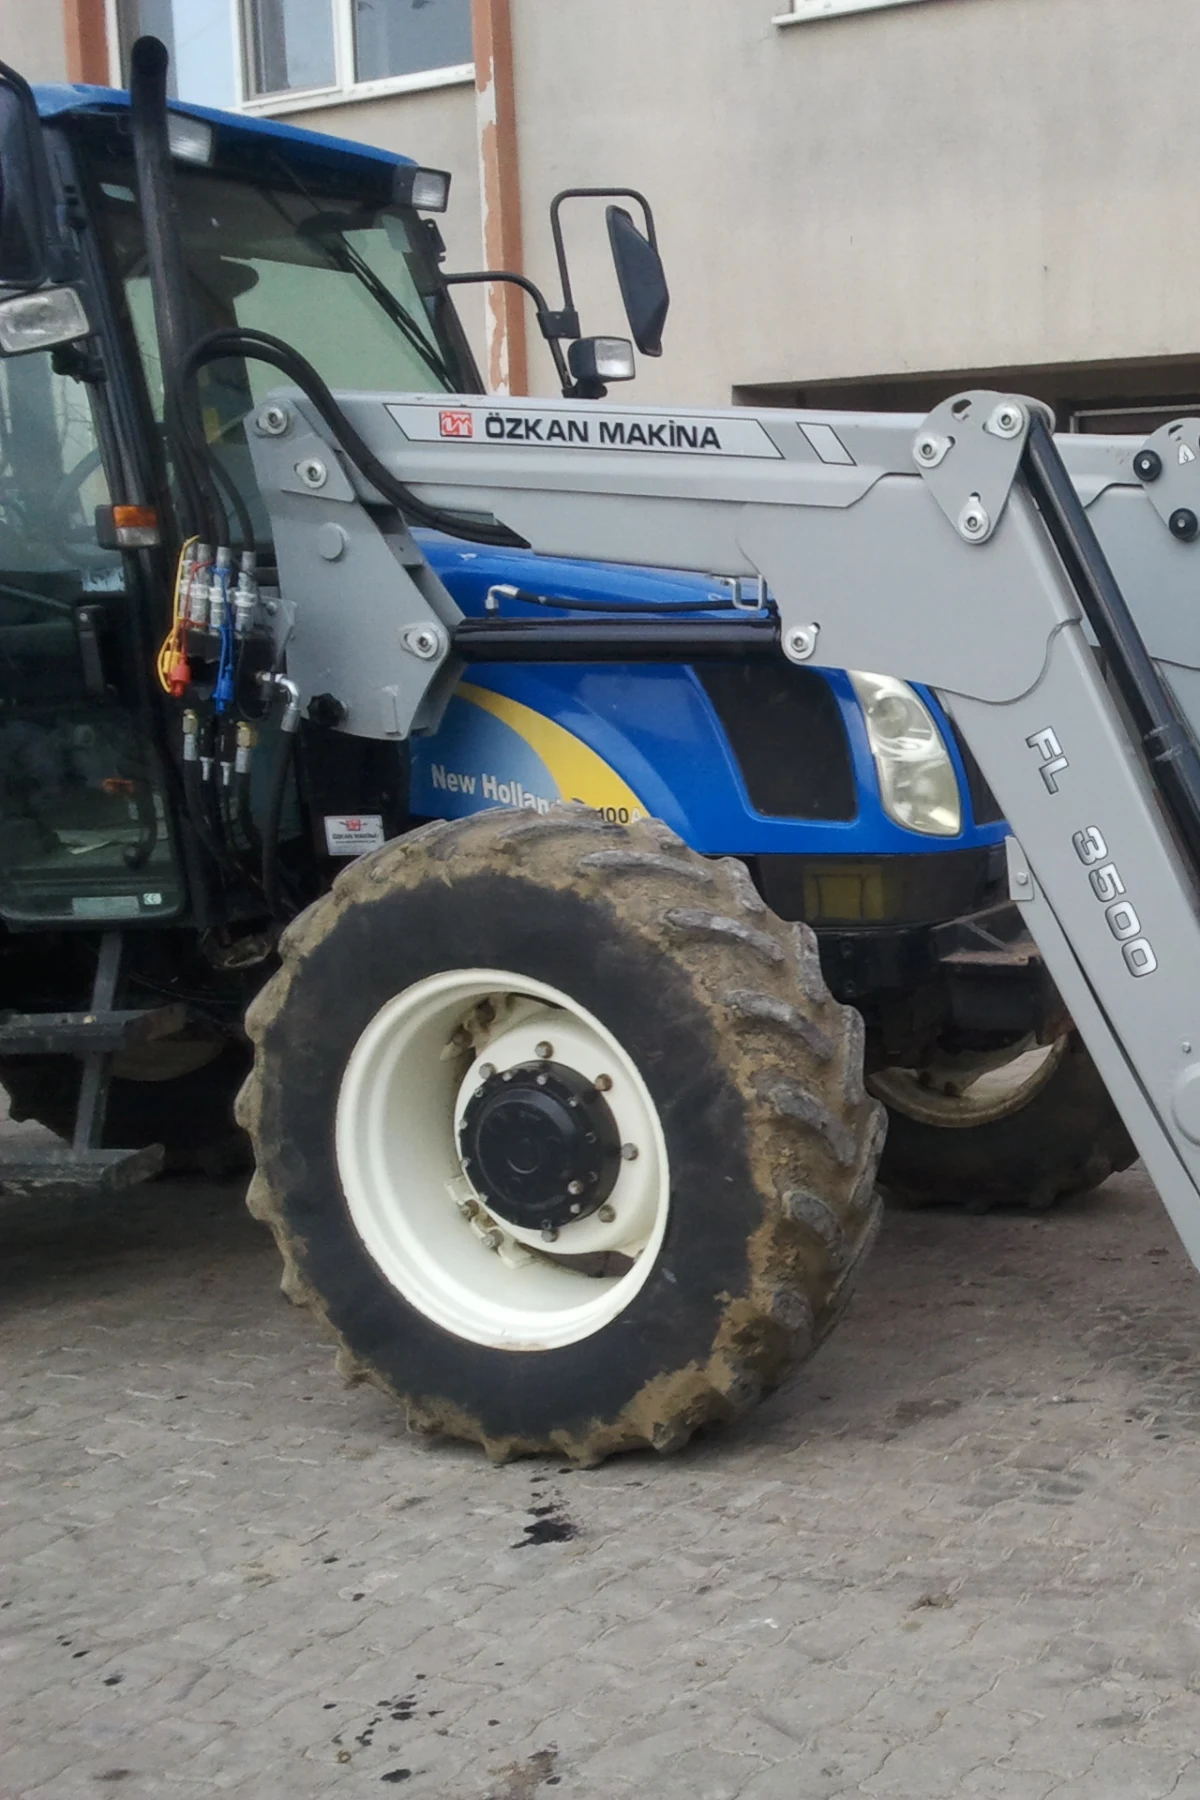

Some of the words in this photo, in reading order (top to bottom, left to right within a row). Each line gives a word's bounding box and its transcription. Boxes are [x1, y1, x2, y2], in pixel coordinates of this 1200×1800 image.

[485, 411, 589, 443] ÖZKAN
[599, 418, 722, 450] MAKİNA
[431, 764, 476, 795] New
[481, 773, 561, 815] Hollan
[1025, 726, 1069, 795] FL
[1071, 825, 1158, 978] 3500
